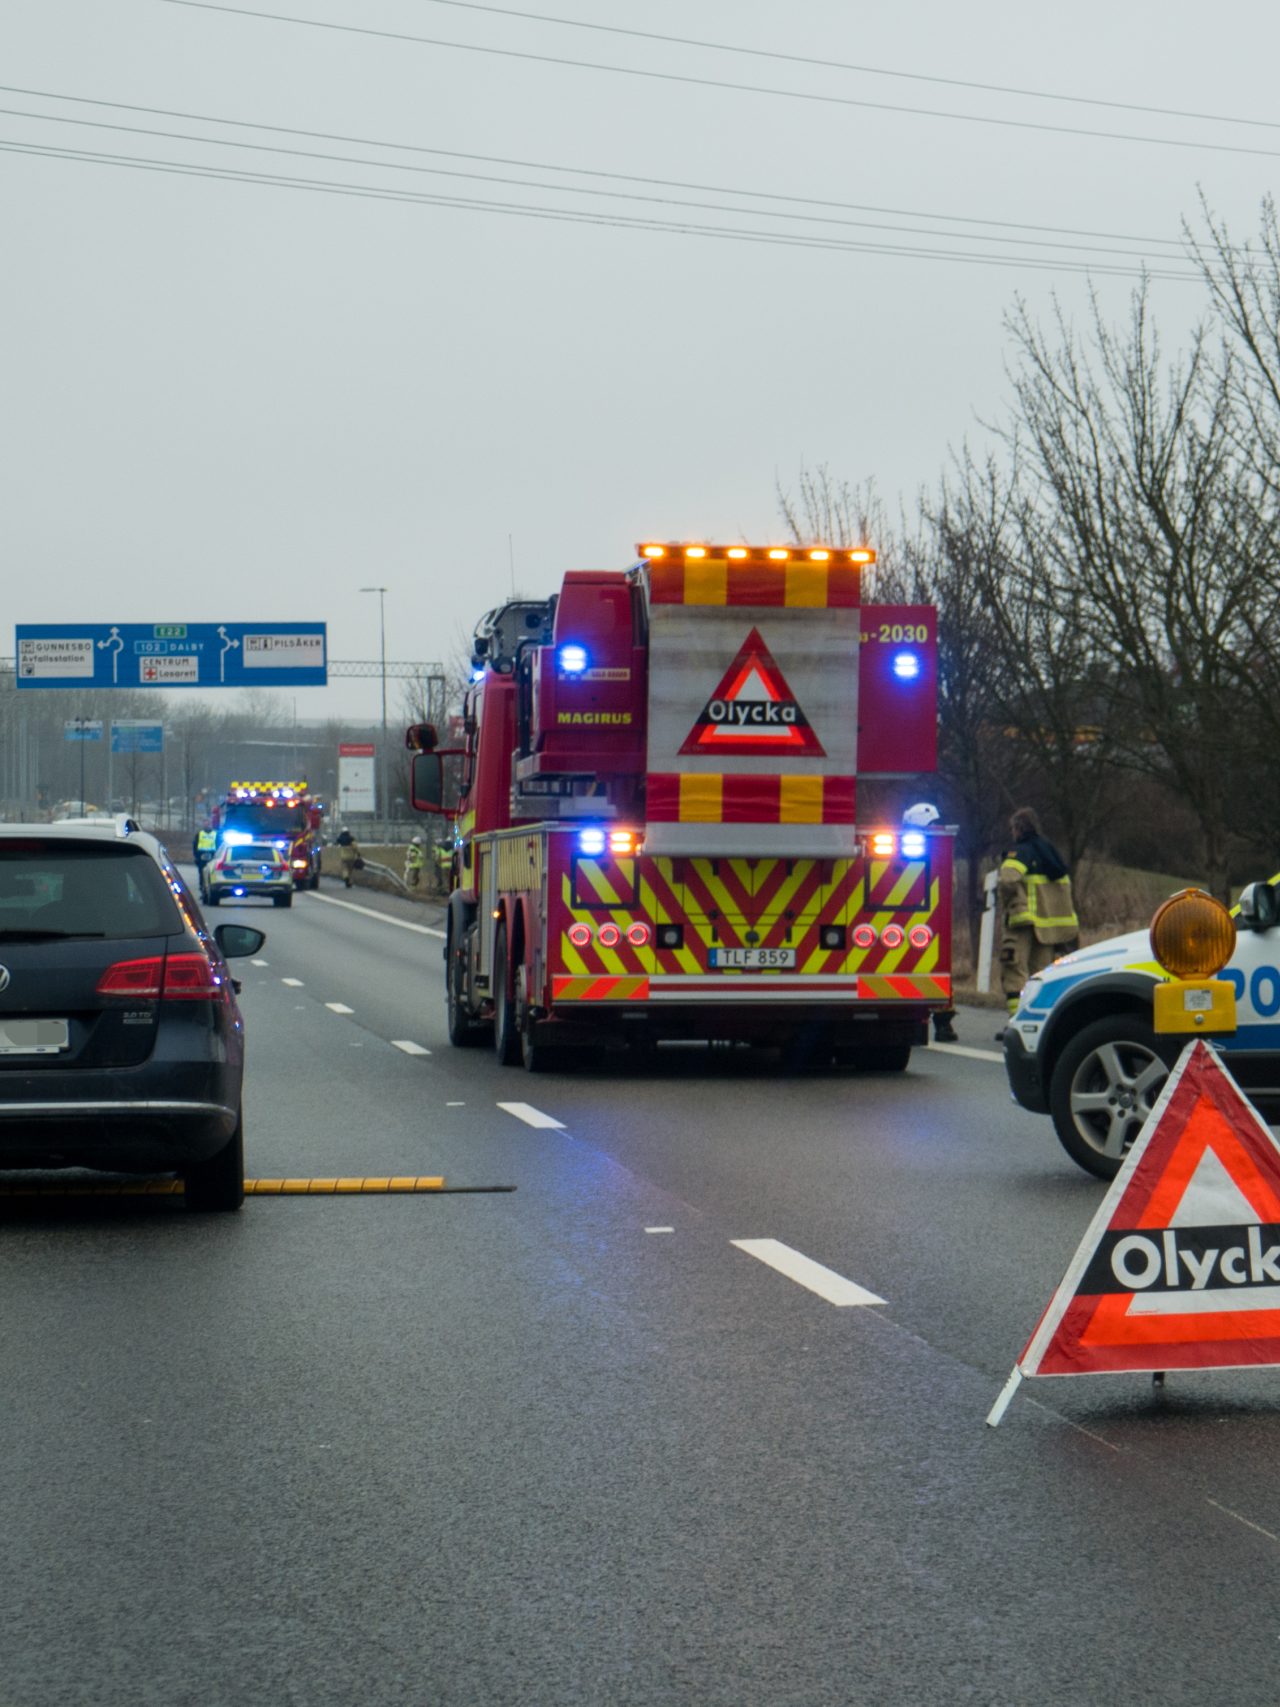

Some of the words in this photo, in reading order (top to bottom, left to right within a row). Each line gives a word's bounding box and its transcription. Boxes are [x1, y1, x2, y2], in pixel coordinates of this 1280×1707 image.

[36, 643, 91, 651] GUNNESBO
[141, 643, 160, 651] 102
[170, 643, 204, 651] DALBY
[275, 638, 321, 648] PILSÅKER
[143, 658, 190, 666] CENTRUM
[557, 712, 632, 724] MAGIRUS
[708, 700, 796, 726] Olycka
[723, 950, 752, 964] TLF
[758, 950, 789, 964] 859
